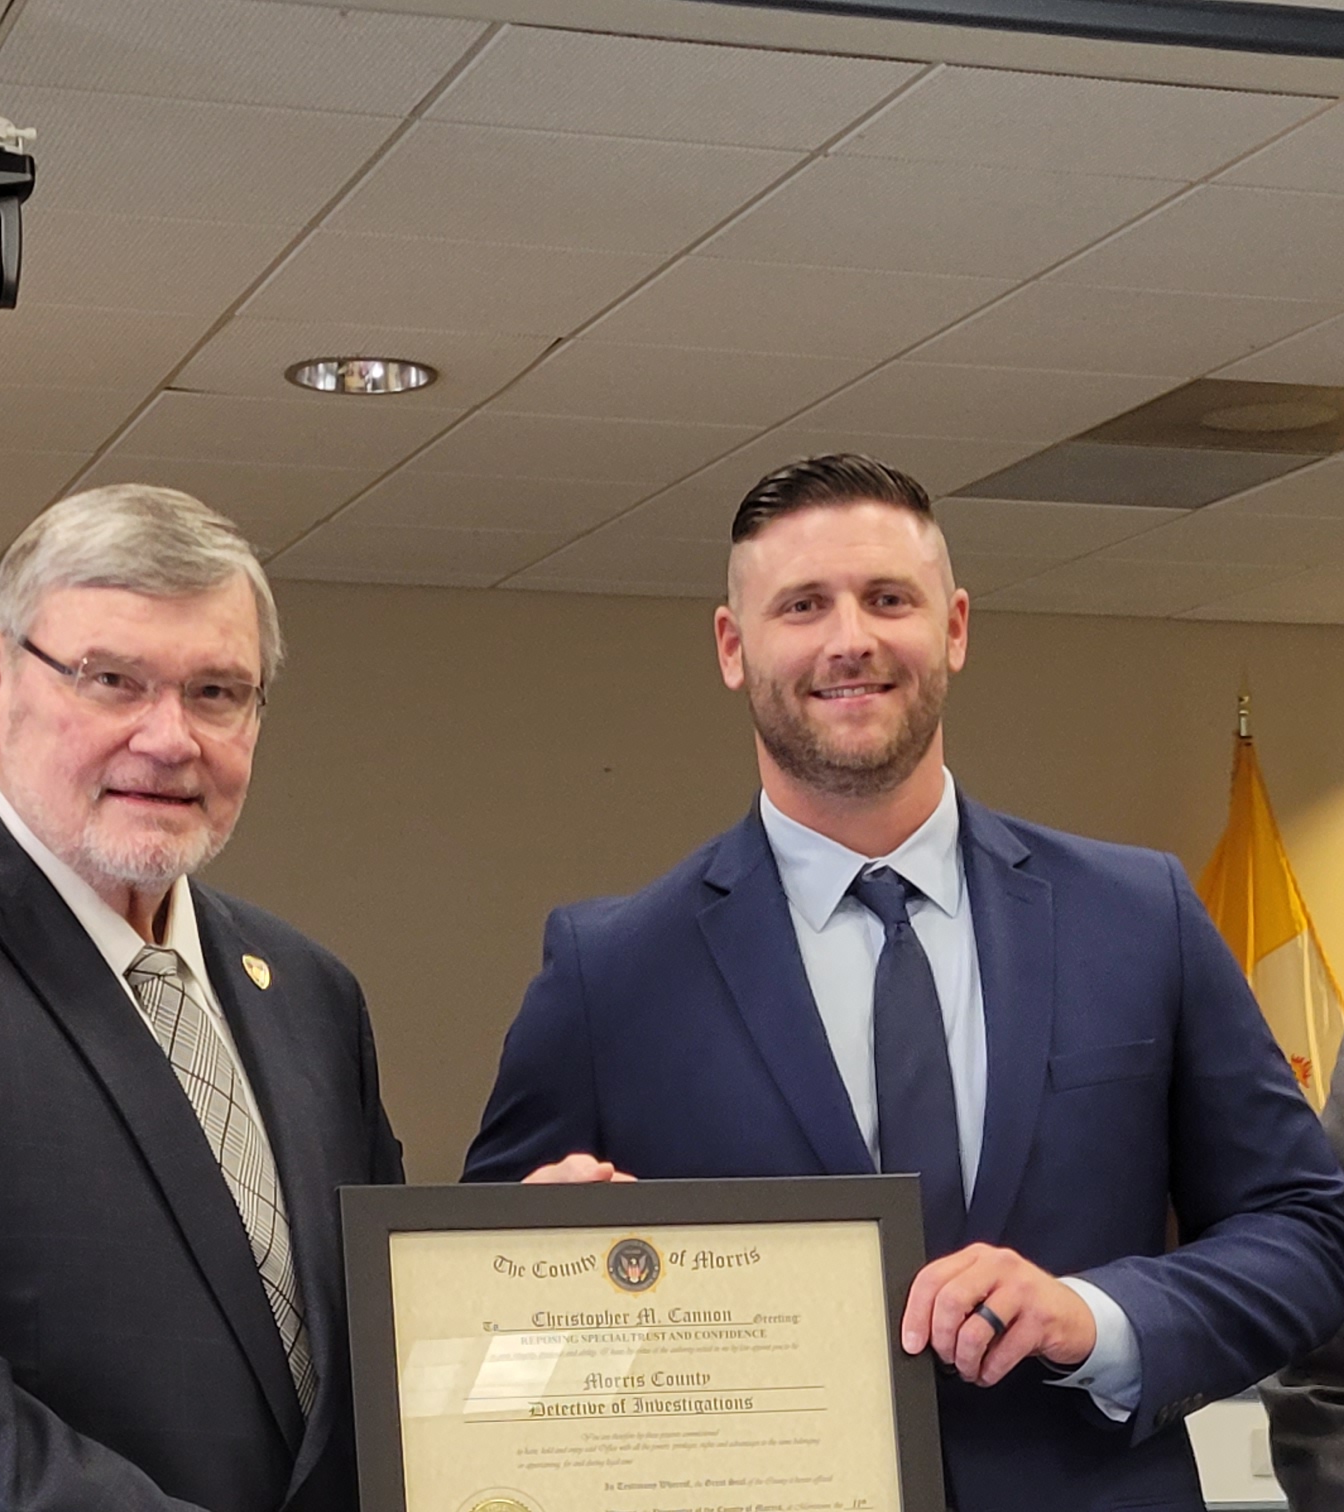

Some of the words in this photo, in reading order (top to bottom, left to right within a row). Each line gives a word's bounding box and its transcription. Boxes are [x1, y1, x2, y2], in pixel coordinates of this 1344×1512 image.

[492, 1254, 526, 1277] The
[532, 1253, 598, 1279] County
[668, 1249, 686, 1267] of
[691, 1246, 761, 1271] Morris
[531, 1309, 630, 1329] Christopher
[636, 1308, 662, 1325] M.
[668, 1307, 733, 1324] Cannon
[520, 1333, 579, 1346] REPOSING
[581, 1331, 630, 1344] SPECIAL
[630, 1331, 667, 1343] TRUST
[669, 1330, 692, 1341] AND
[694, 1328, 767, 1340] CONFIDENCE
[582, 1371, 646, 1391] Morris
[650, 1370, 711, 1388] County
[528, 1400, 606, 1418] Detective
[611, 1398, 626, 1414] of
[632, 1396, 754, 1414] Investigations
